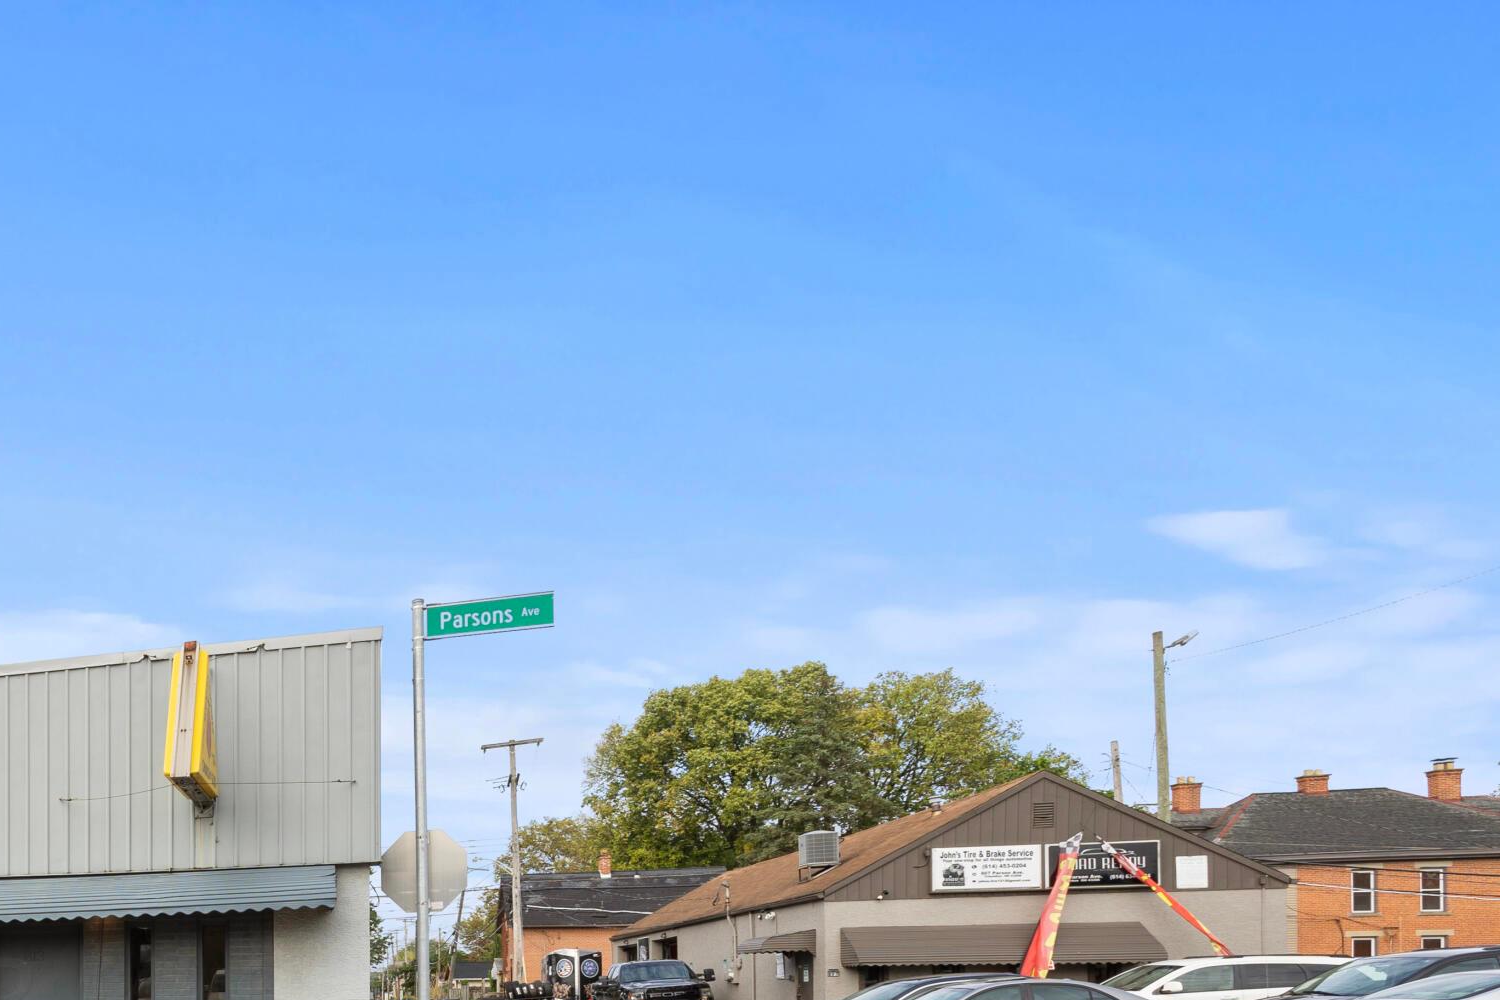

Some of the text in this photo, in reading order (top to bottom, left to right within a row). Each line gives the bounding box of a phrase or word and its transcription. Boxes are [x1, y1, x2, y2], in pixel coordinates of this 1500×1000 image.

[440, 607, 540, 630] Parsons Ave
[940, 849, 1034, 859] John's Tire & Brake Service
